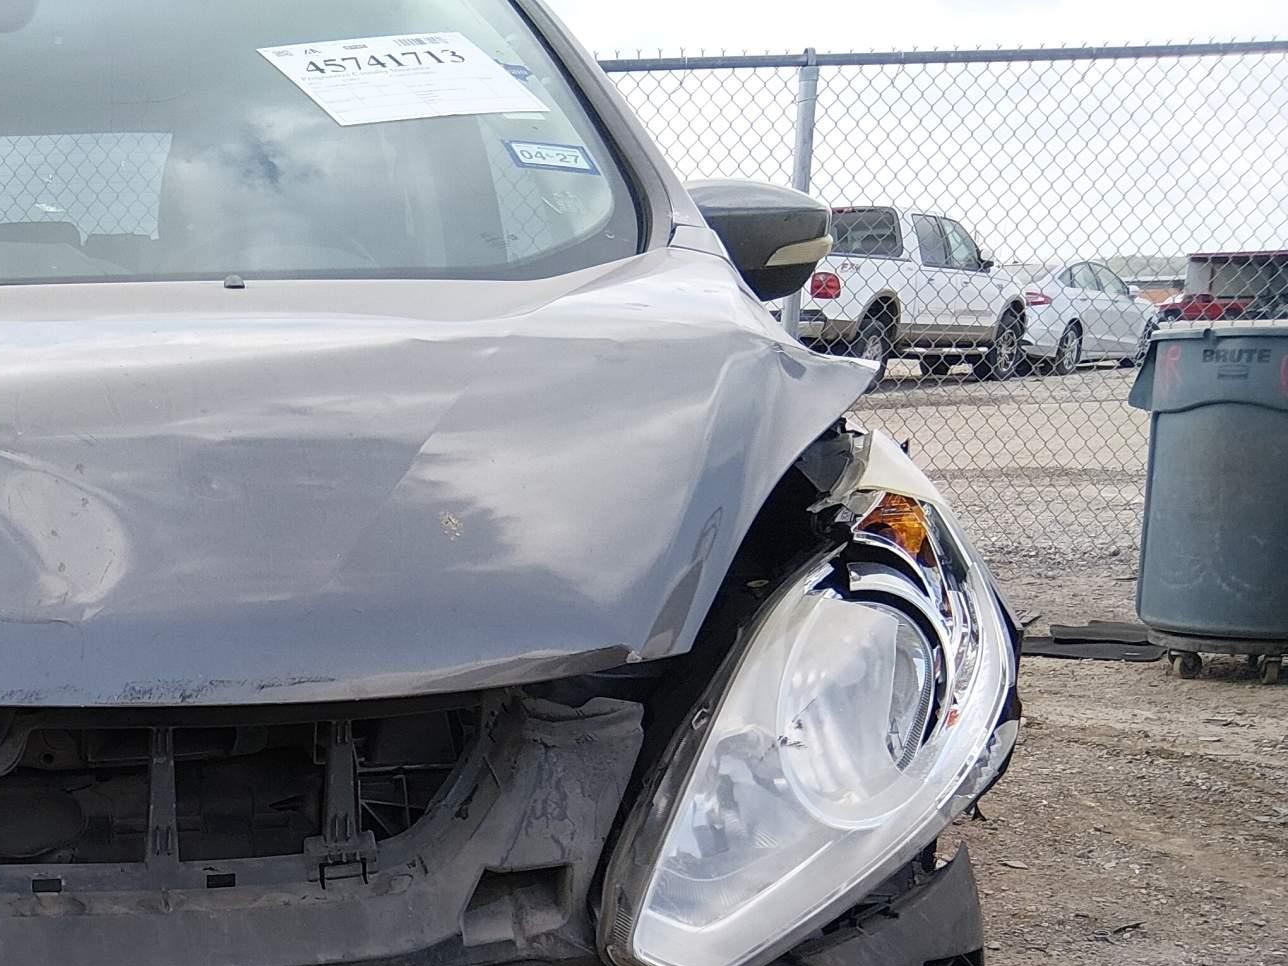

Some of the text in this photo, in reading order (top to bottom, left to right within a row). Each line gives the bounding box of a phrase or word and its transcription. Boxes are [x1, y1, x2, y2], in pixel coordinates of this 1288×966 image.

[306, 49, 465, 74] 45741713
[519, 149, 579, 164] 04-27
[1203, 348, 1272, 363] BRUTE
